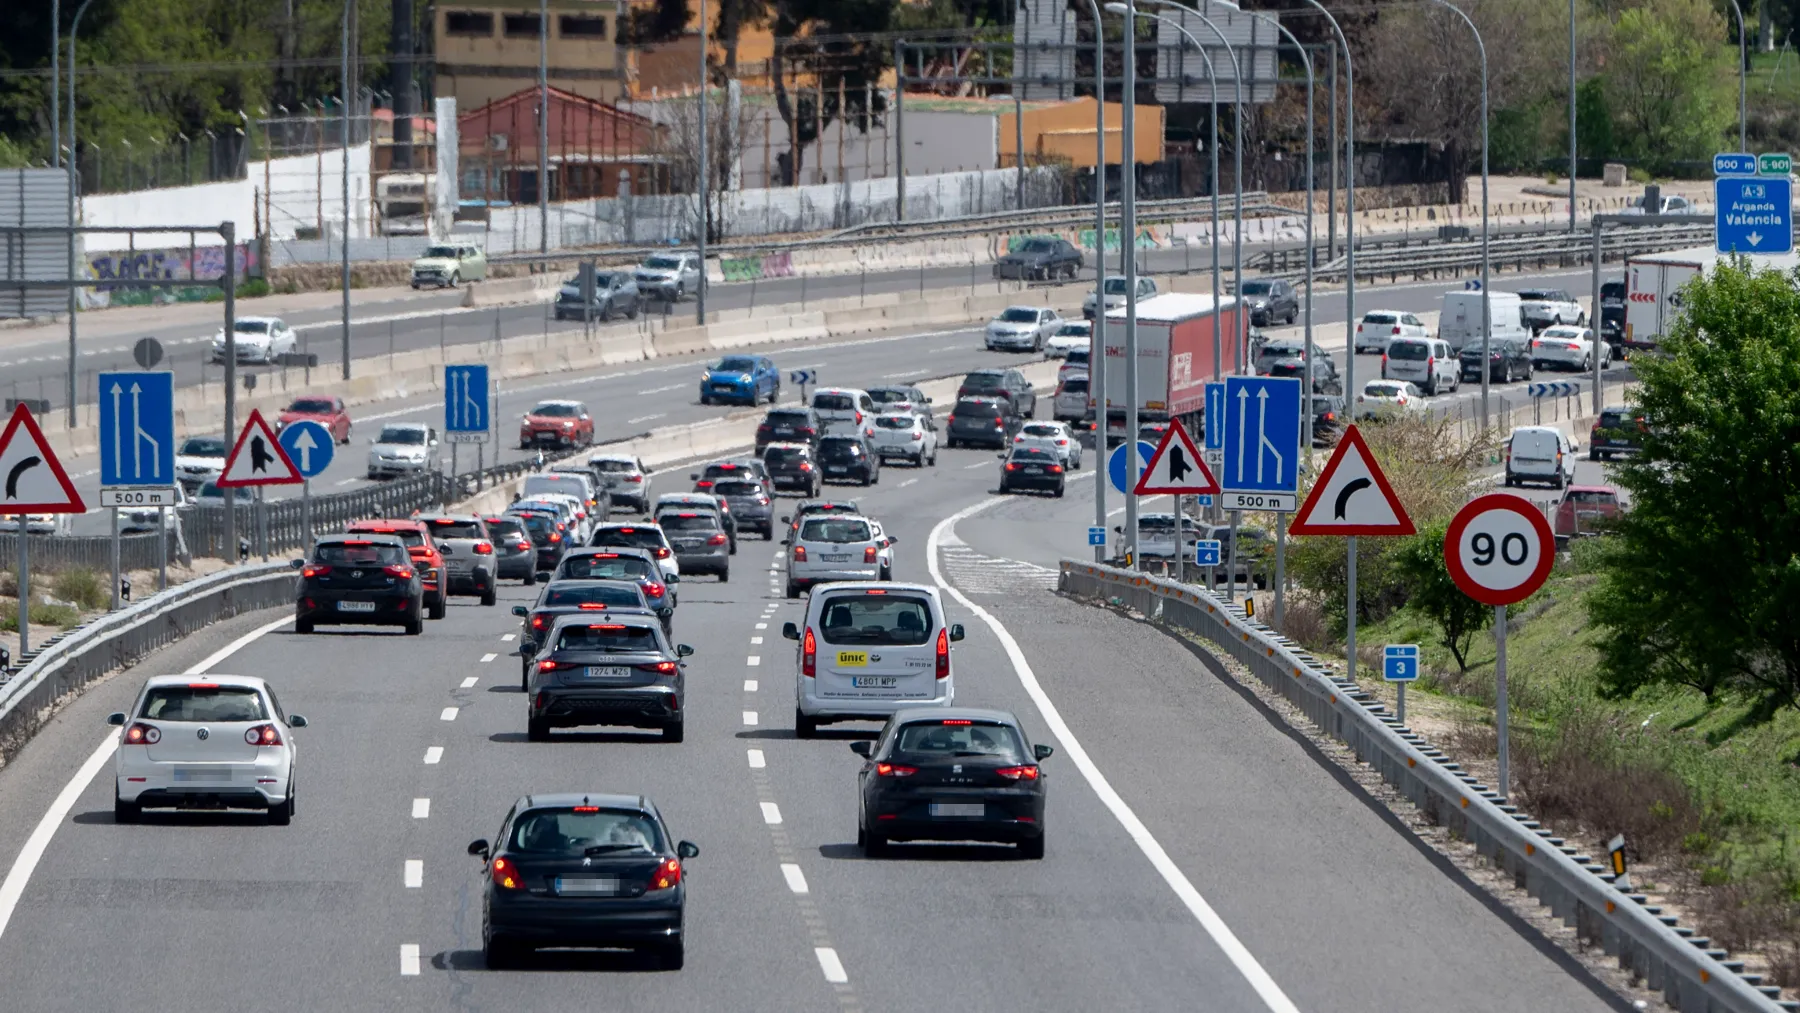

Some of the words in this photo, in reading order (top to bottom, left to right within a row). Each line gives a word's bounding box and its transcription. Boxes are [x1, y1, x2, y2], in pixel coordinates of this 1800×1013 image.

[1717, 160, 1738, 170] 500
[1744, 162, 1754, 170] m
[1761, 160, 1789, 170] E-901
[1744, 185, 1763, 197] A-3
[1732, 201, 1775, 212] Arganda
[1726, 213, 1782, 225] Valencia
[115, 493, 144, 504] 500
[150, 494, 161, 503] m
[1238, 496, 1264, 507] 500
[1269, 498, 1281, 508] m
[1471, 532, 1529, 567] 90
[1204, 552, 1213, 562] 4
[1396, 648, 1406, 656] 14
[590, 667, 609, 677] 1274
[612, 667, 629, 677] MZS
[1396, 661, 1406, 675] 3
[857, 677, 879, 687] 4801
[881, 677, 897, 687] MPP
